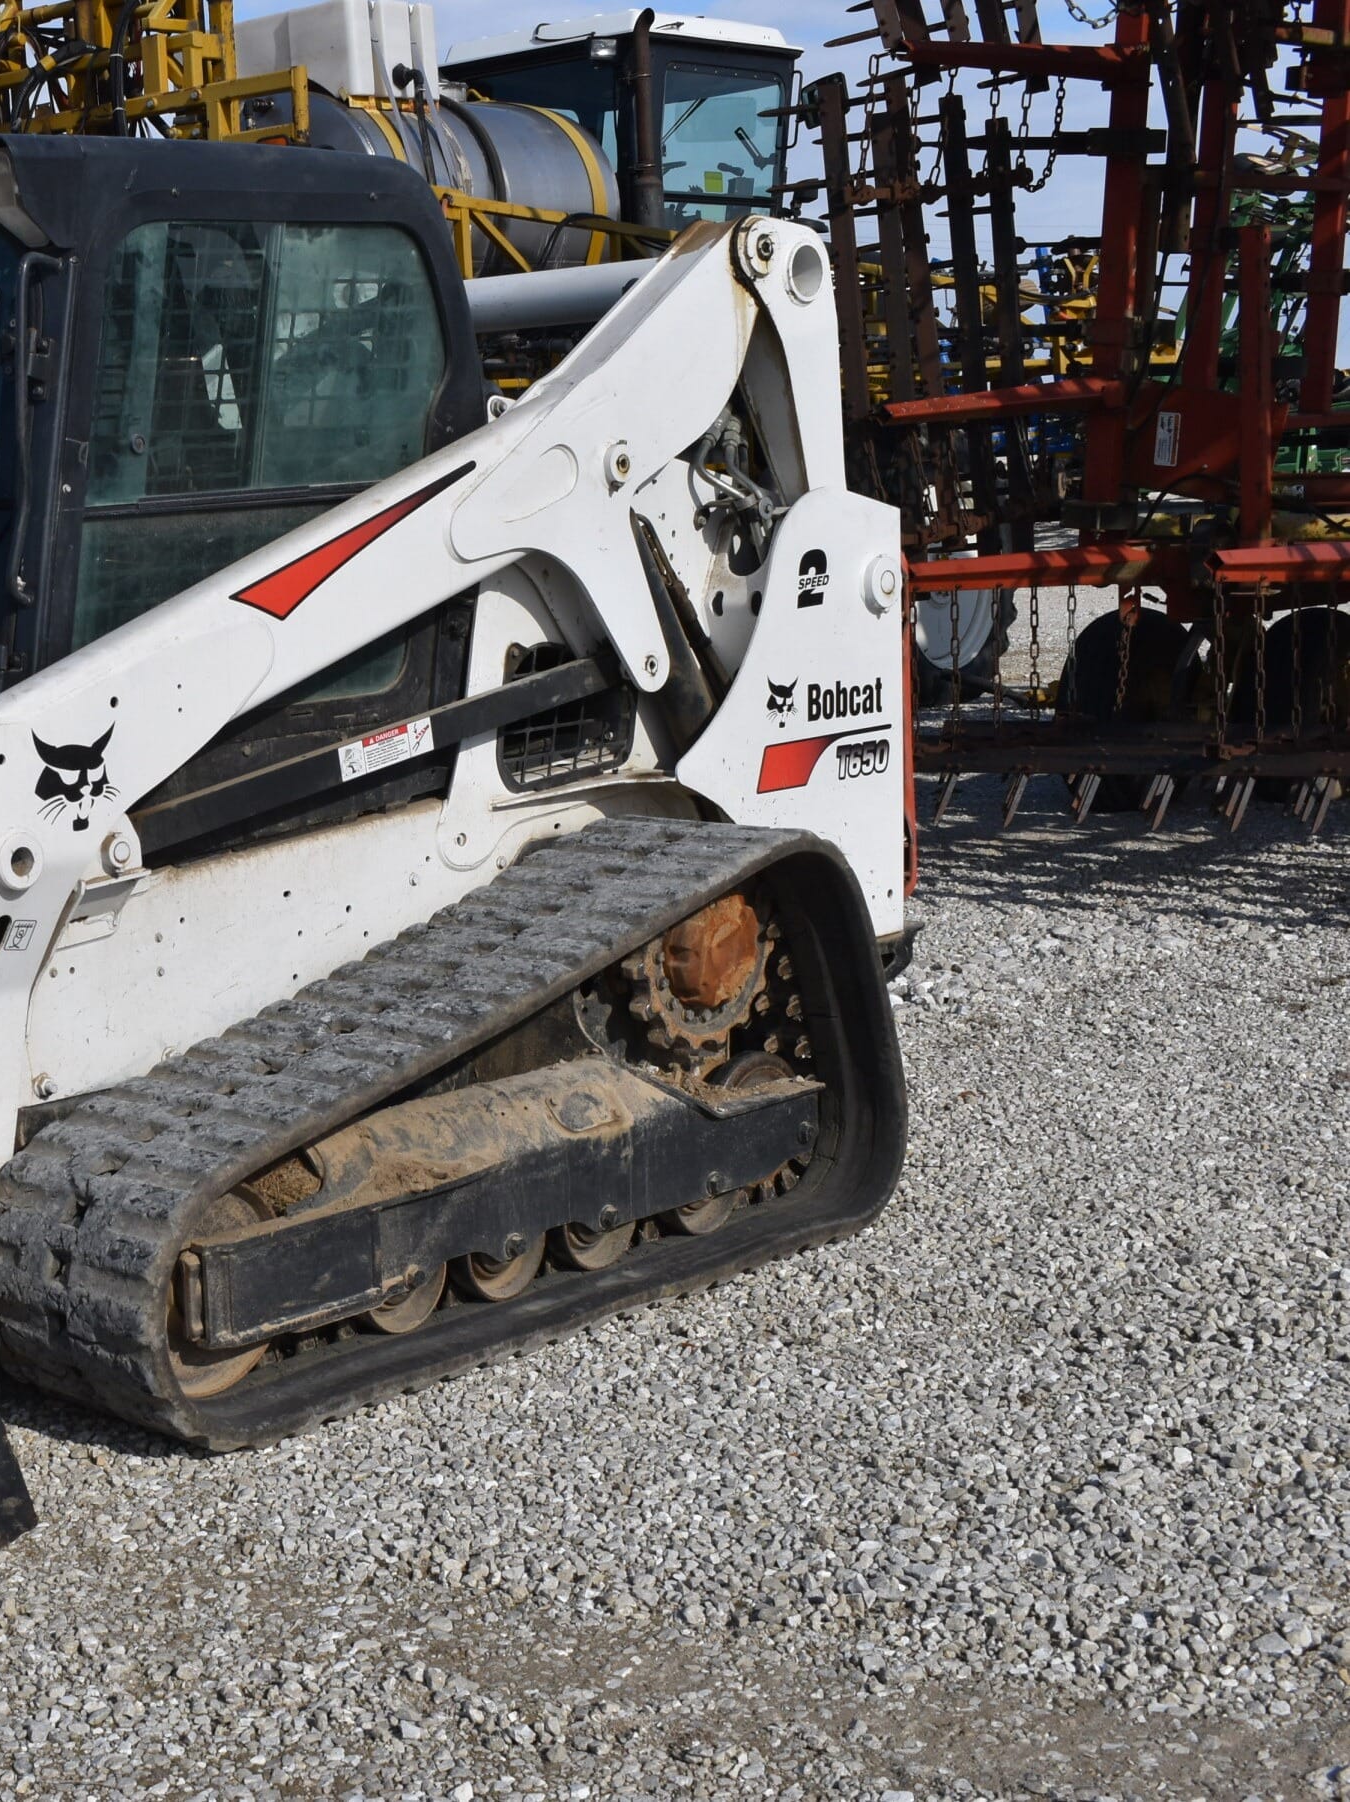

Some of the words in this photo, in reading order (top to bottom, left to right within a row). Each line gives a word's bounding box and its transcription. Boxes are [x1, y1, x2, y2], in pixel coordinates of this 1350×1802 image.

[798, 574, 830, 590] SPEED
[807, 677, 883, 722] Bobcat
[374, 728, 399, 743] DANGER
[836, 739, 890, 780] T650
